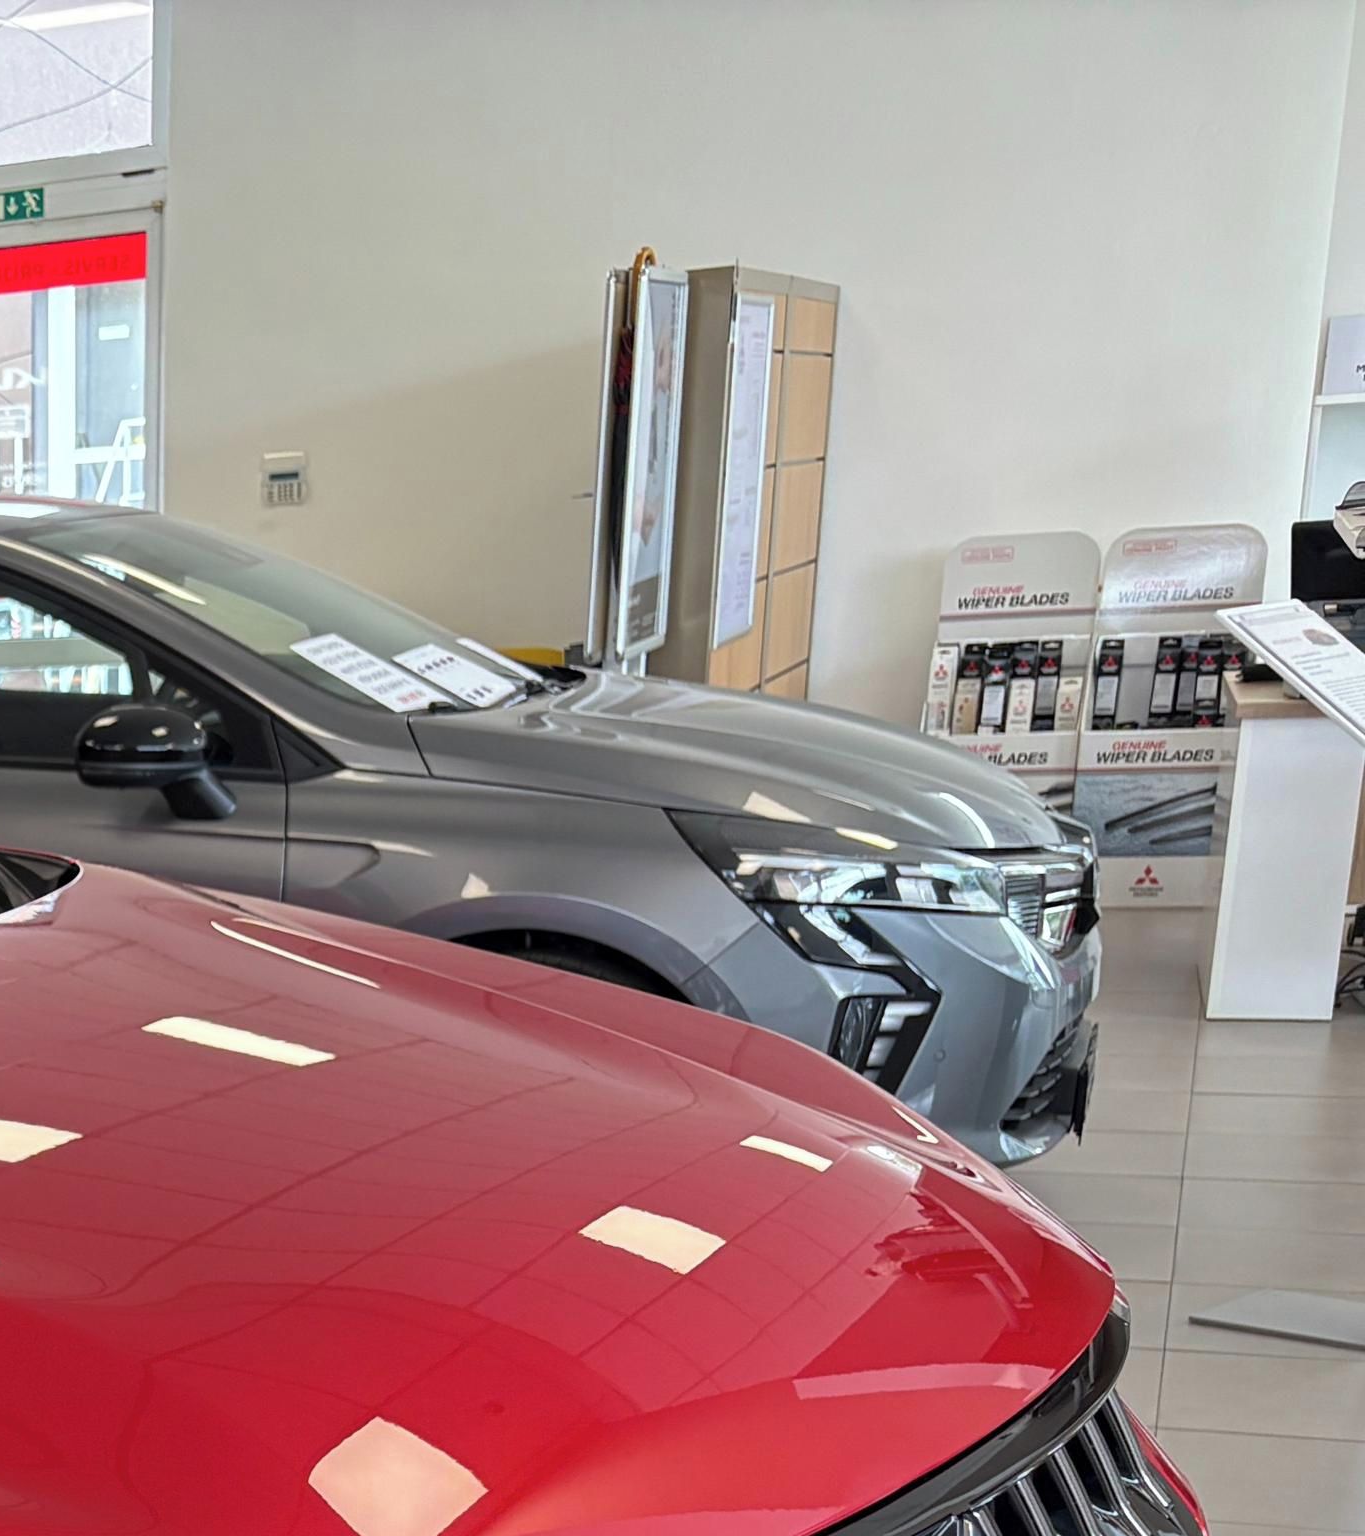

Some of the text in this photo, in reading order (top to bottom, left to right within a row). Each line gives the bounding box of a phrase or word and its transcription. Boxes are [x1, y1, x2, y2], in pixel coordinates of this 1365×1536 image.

[972, 584, 1025, 596] GENUINE
[1118, 586, 1234, 603] WIPER BLADES
[958, 592, 1069, 610] WIPER BLADES
[1112, 740, 1167, 751] GENUINE
[1096, 748, 1215, 764] WIPER BLADES
